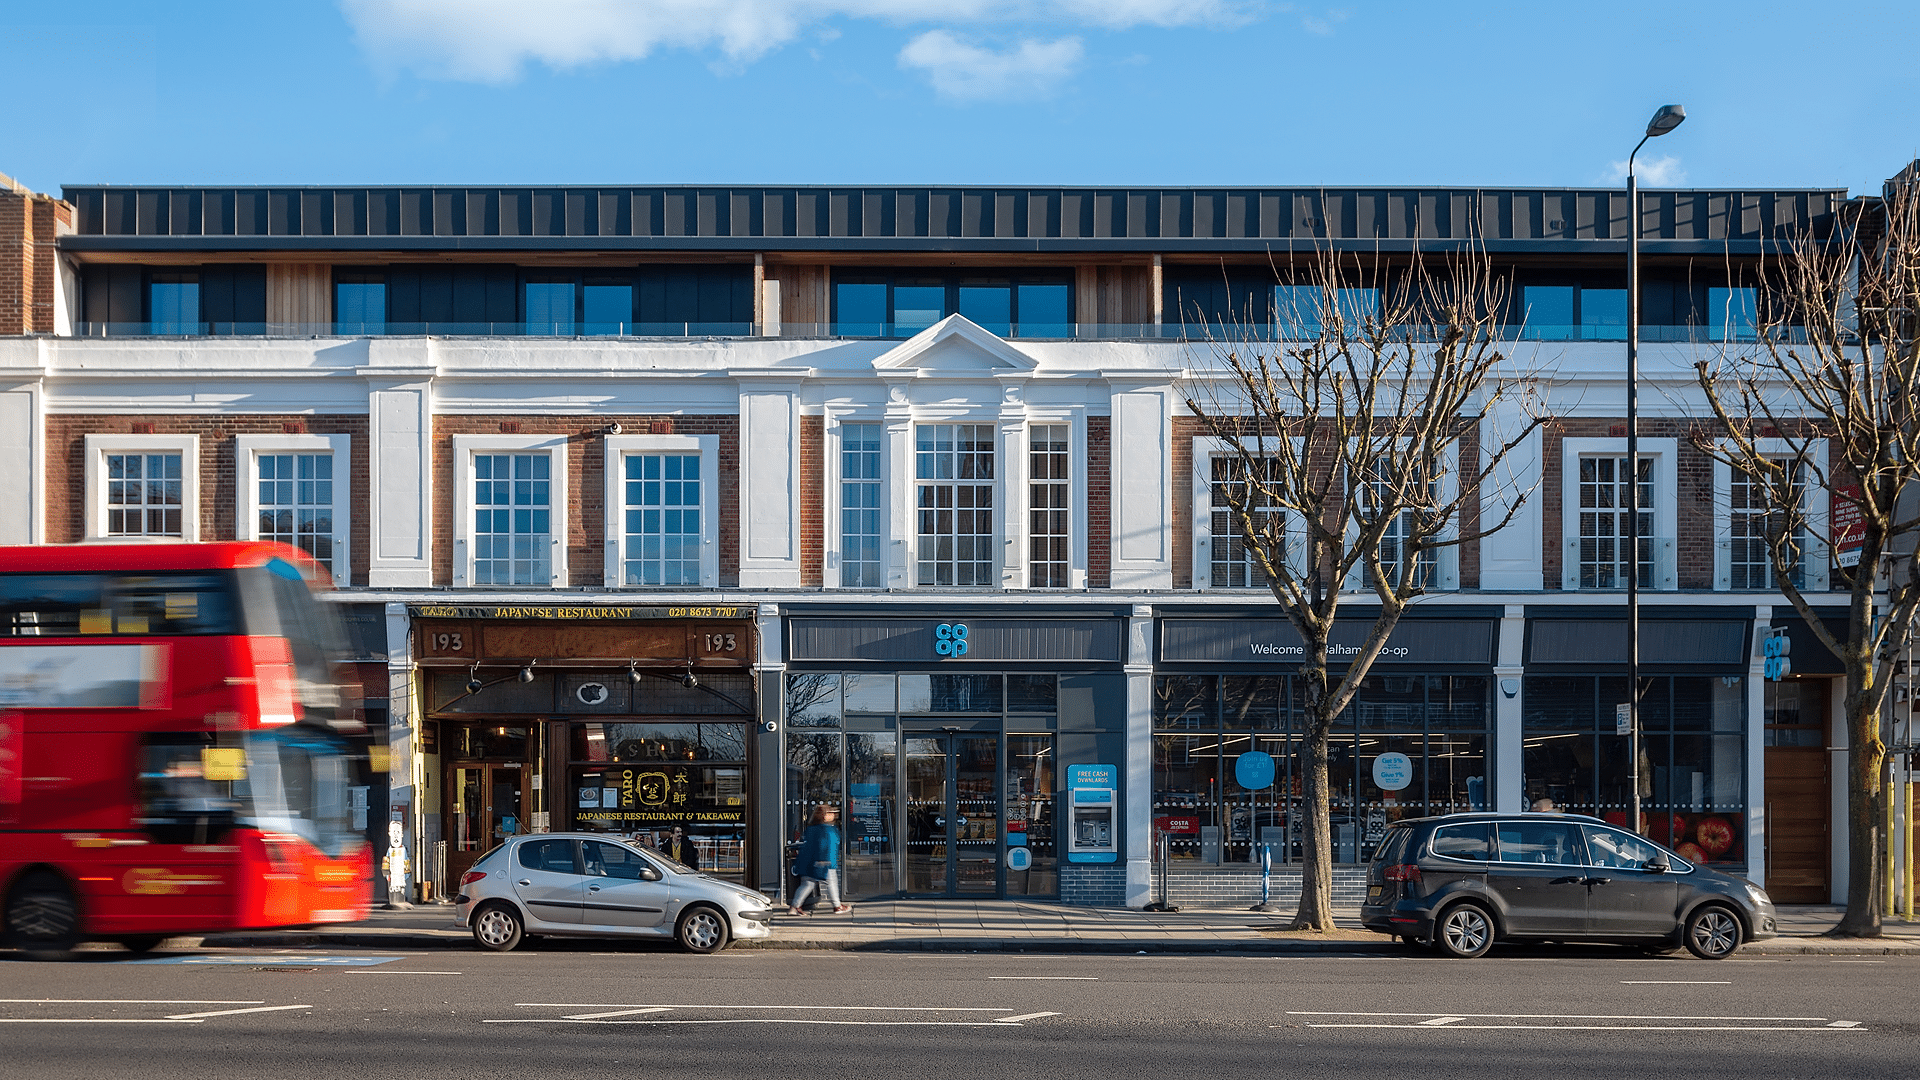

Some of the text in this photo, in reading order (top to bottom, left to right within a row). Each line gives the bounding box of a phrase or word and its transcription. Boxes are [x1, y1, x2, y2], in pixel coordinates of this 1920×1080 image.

[421, 606, 738, 618] TARO JAPANESE RESTAURANT 020 8673 7707
[431, 633, 463, 651] 193
[705, 633, 737, 652] 193
[1250, 643, 1304, 655] Welcome
[1327, 754, 1338, 762] nly
[1077, 770, 1109, 778] FREE CASH
[622, 769, 633, 807] TARO
[576, 812, 742, 821] JAPANESE RESTAURANT & TAKEAWAY
